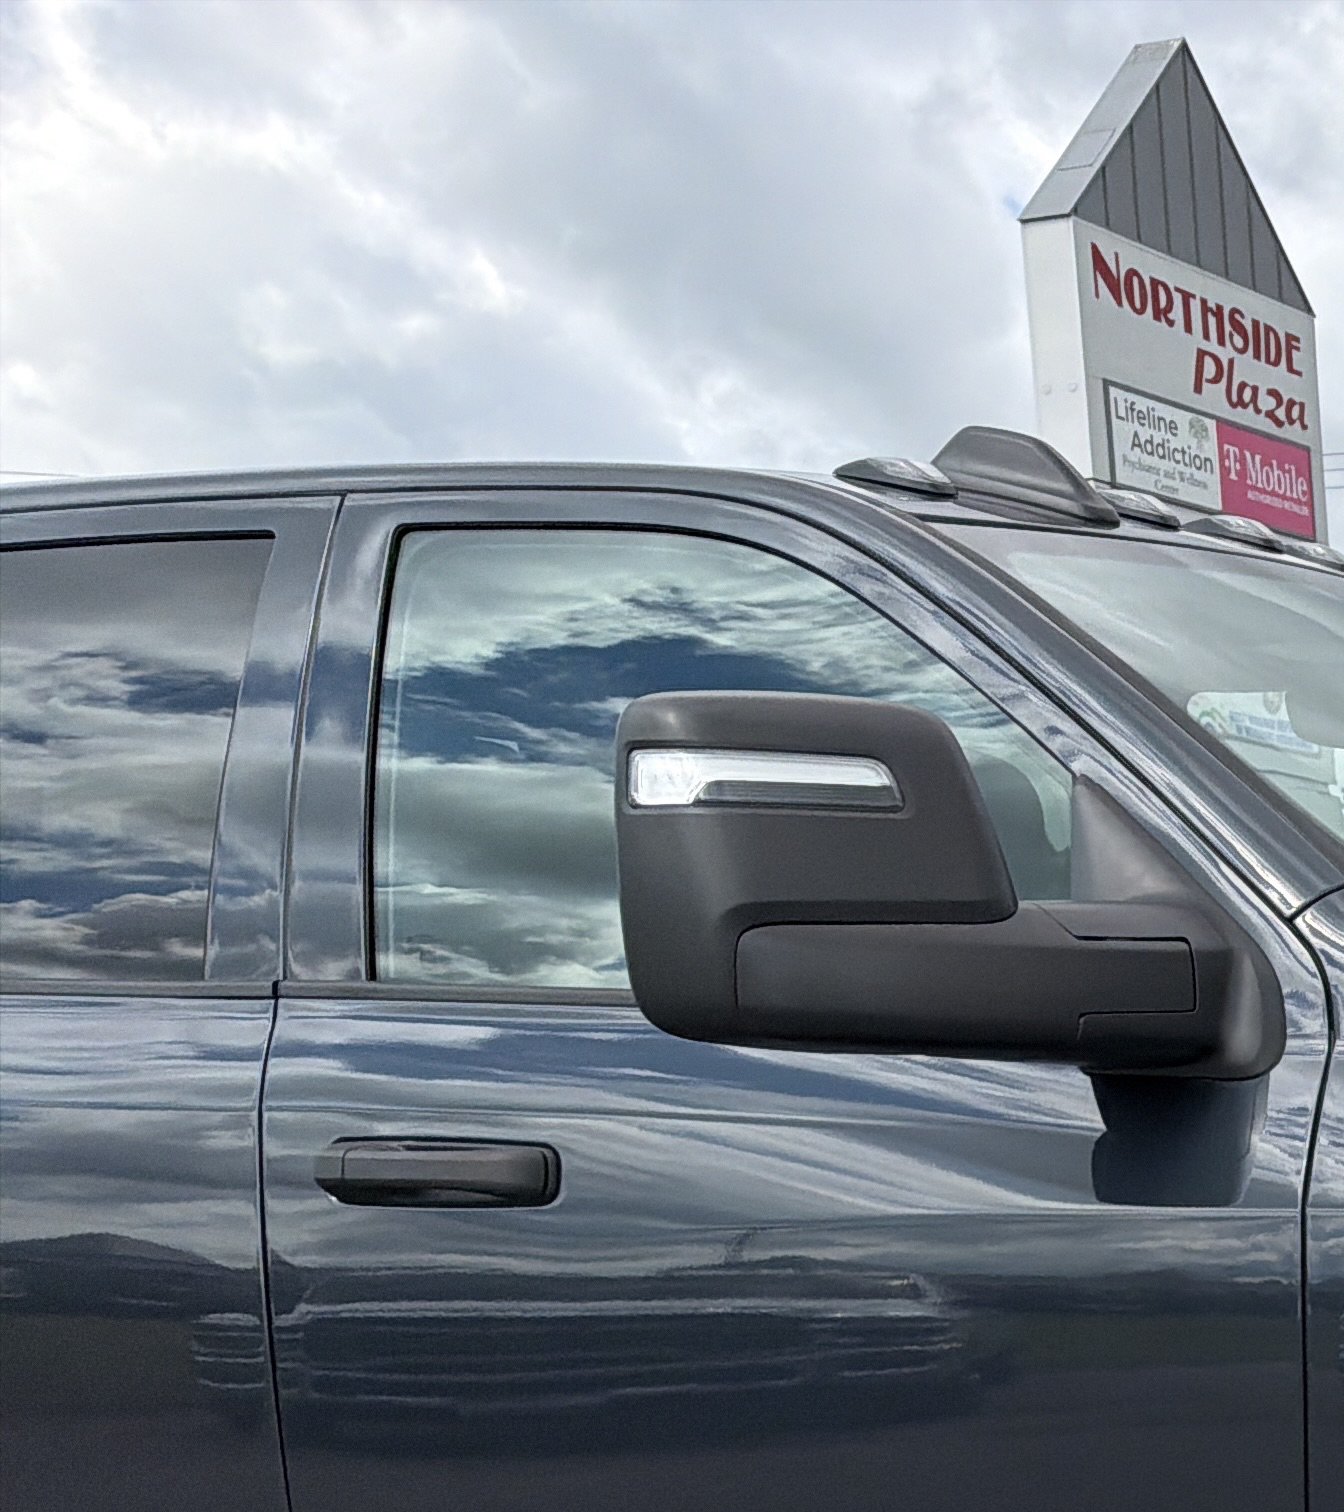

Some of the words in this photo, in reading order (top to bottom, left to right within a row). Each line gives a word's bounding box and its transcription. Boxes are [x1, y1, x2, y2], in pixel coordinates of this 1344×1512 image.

[1090, 241, 1303, 378] NORTHSIDE
[1192, 347, 1309, 431] Plaza
[1113, 397, 1179, 438] Lifeline
[1130, 431, 1215, 475] Addiction
[1243, 449, 1309, 502] Mobile
